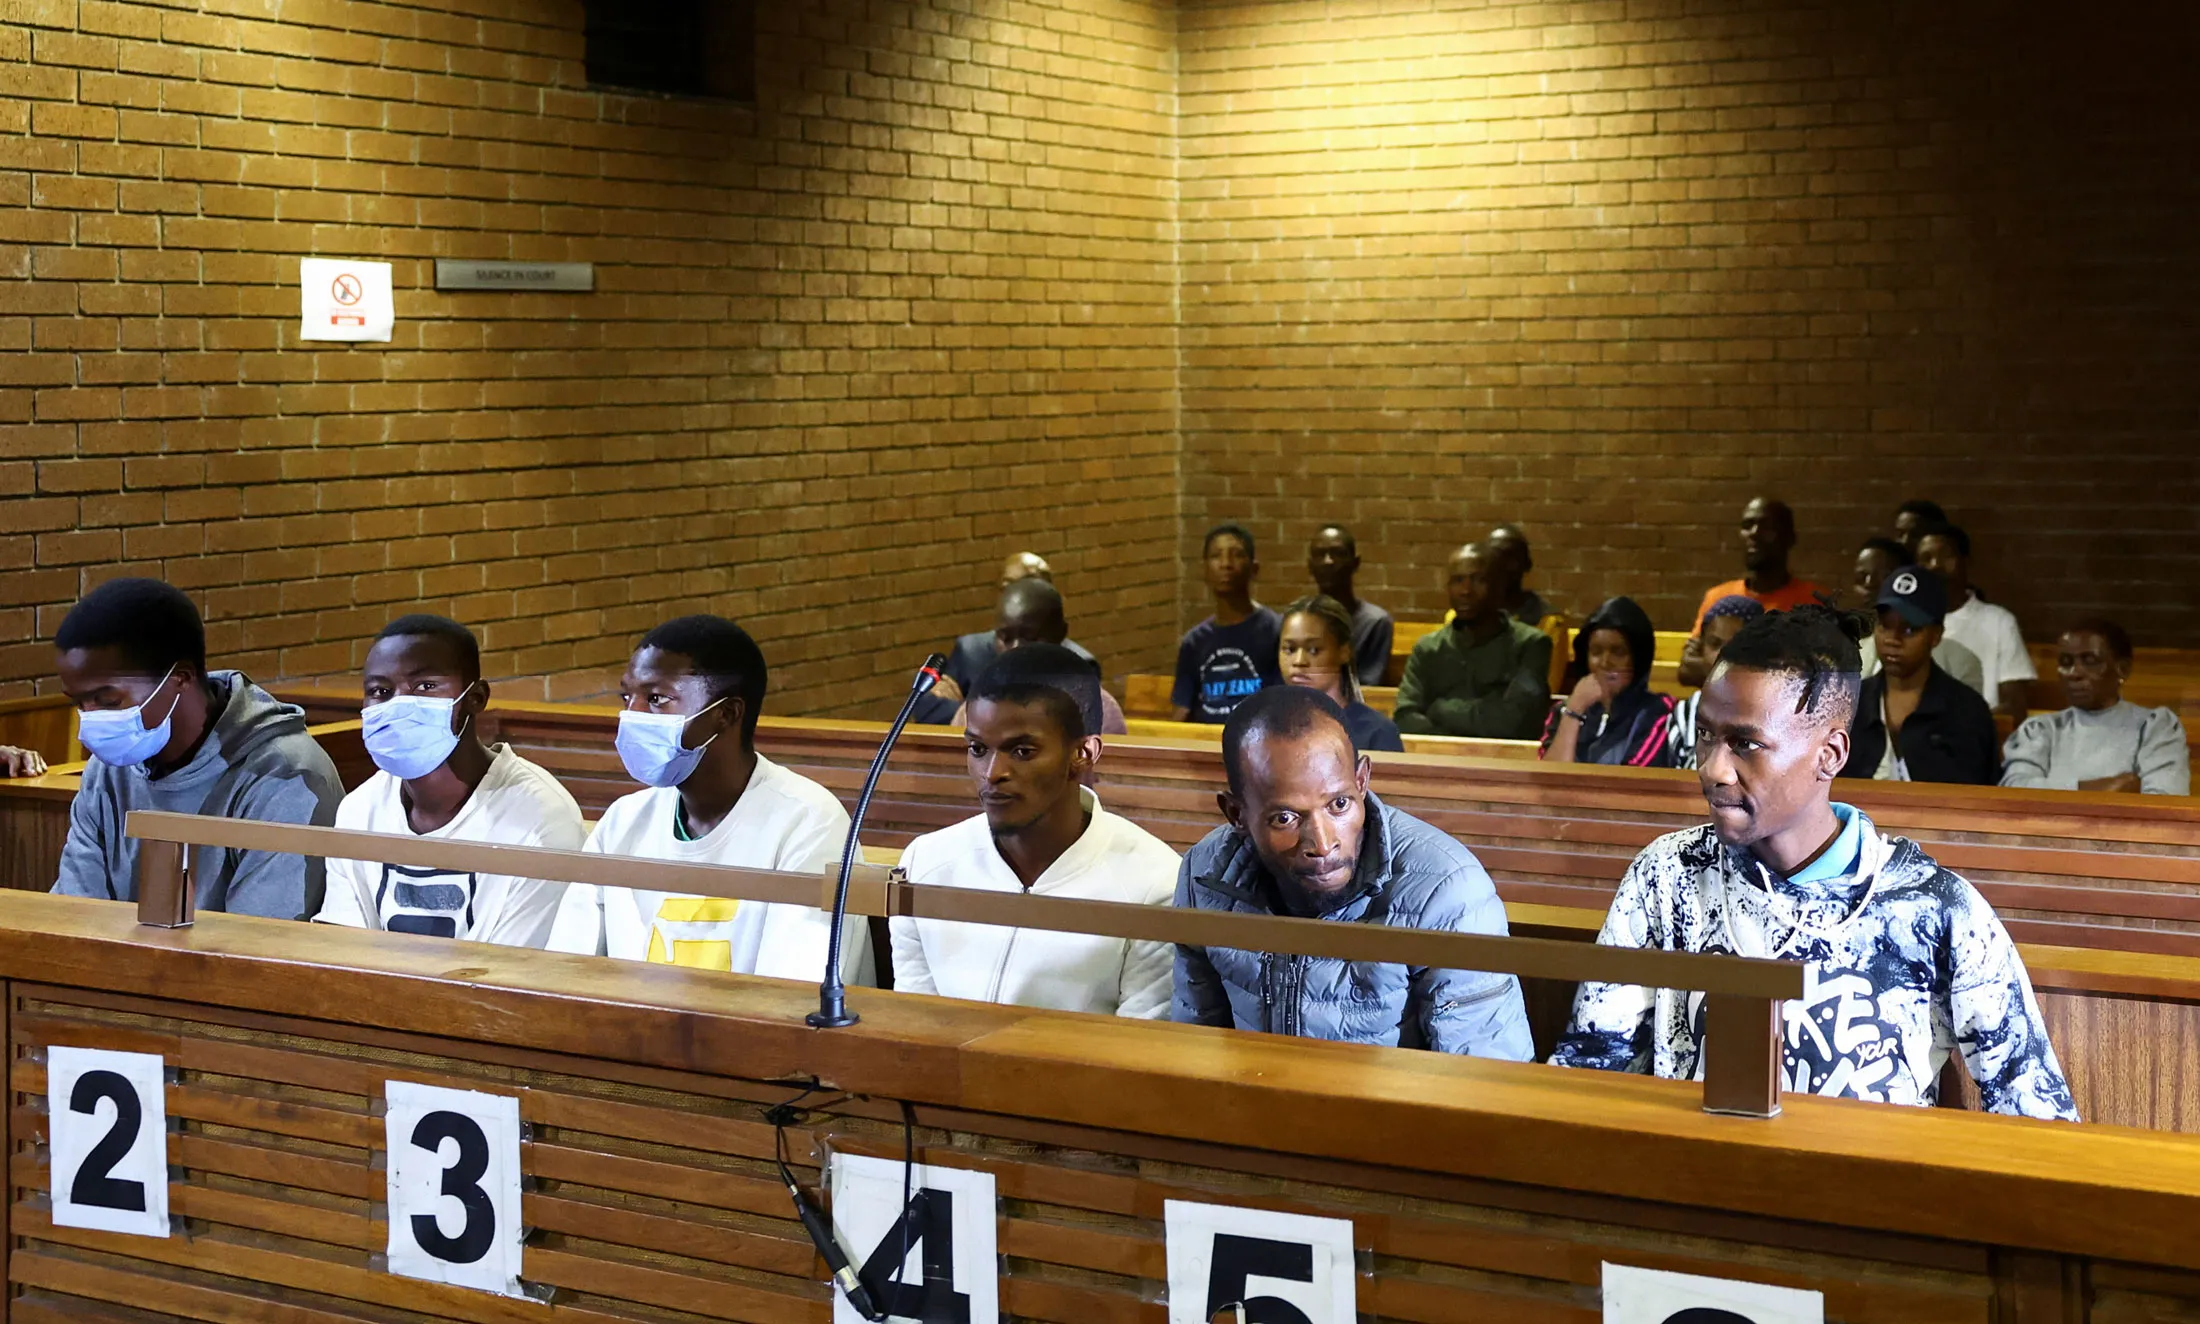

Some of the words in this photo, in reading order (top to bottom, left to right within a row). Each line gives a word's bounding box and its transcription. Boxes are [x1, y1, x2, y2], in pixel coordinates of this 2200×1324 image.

[476, 269, 510, 281] SILENCE
[513, 270, 524, 281] IN
[527, 270, 556, 282] COURT
[1855, 1037, 1899, 1069] YOUR
[69, 1070, 146, 1212] 2
[410, 1110, 496, 1264] 3
[858, 1187, 971, 1324] 4
